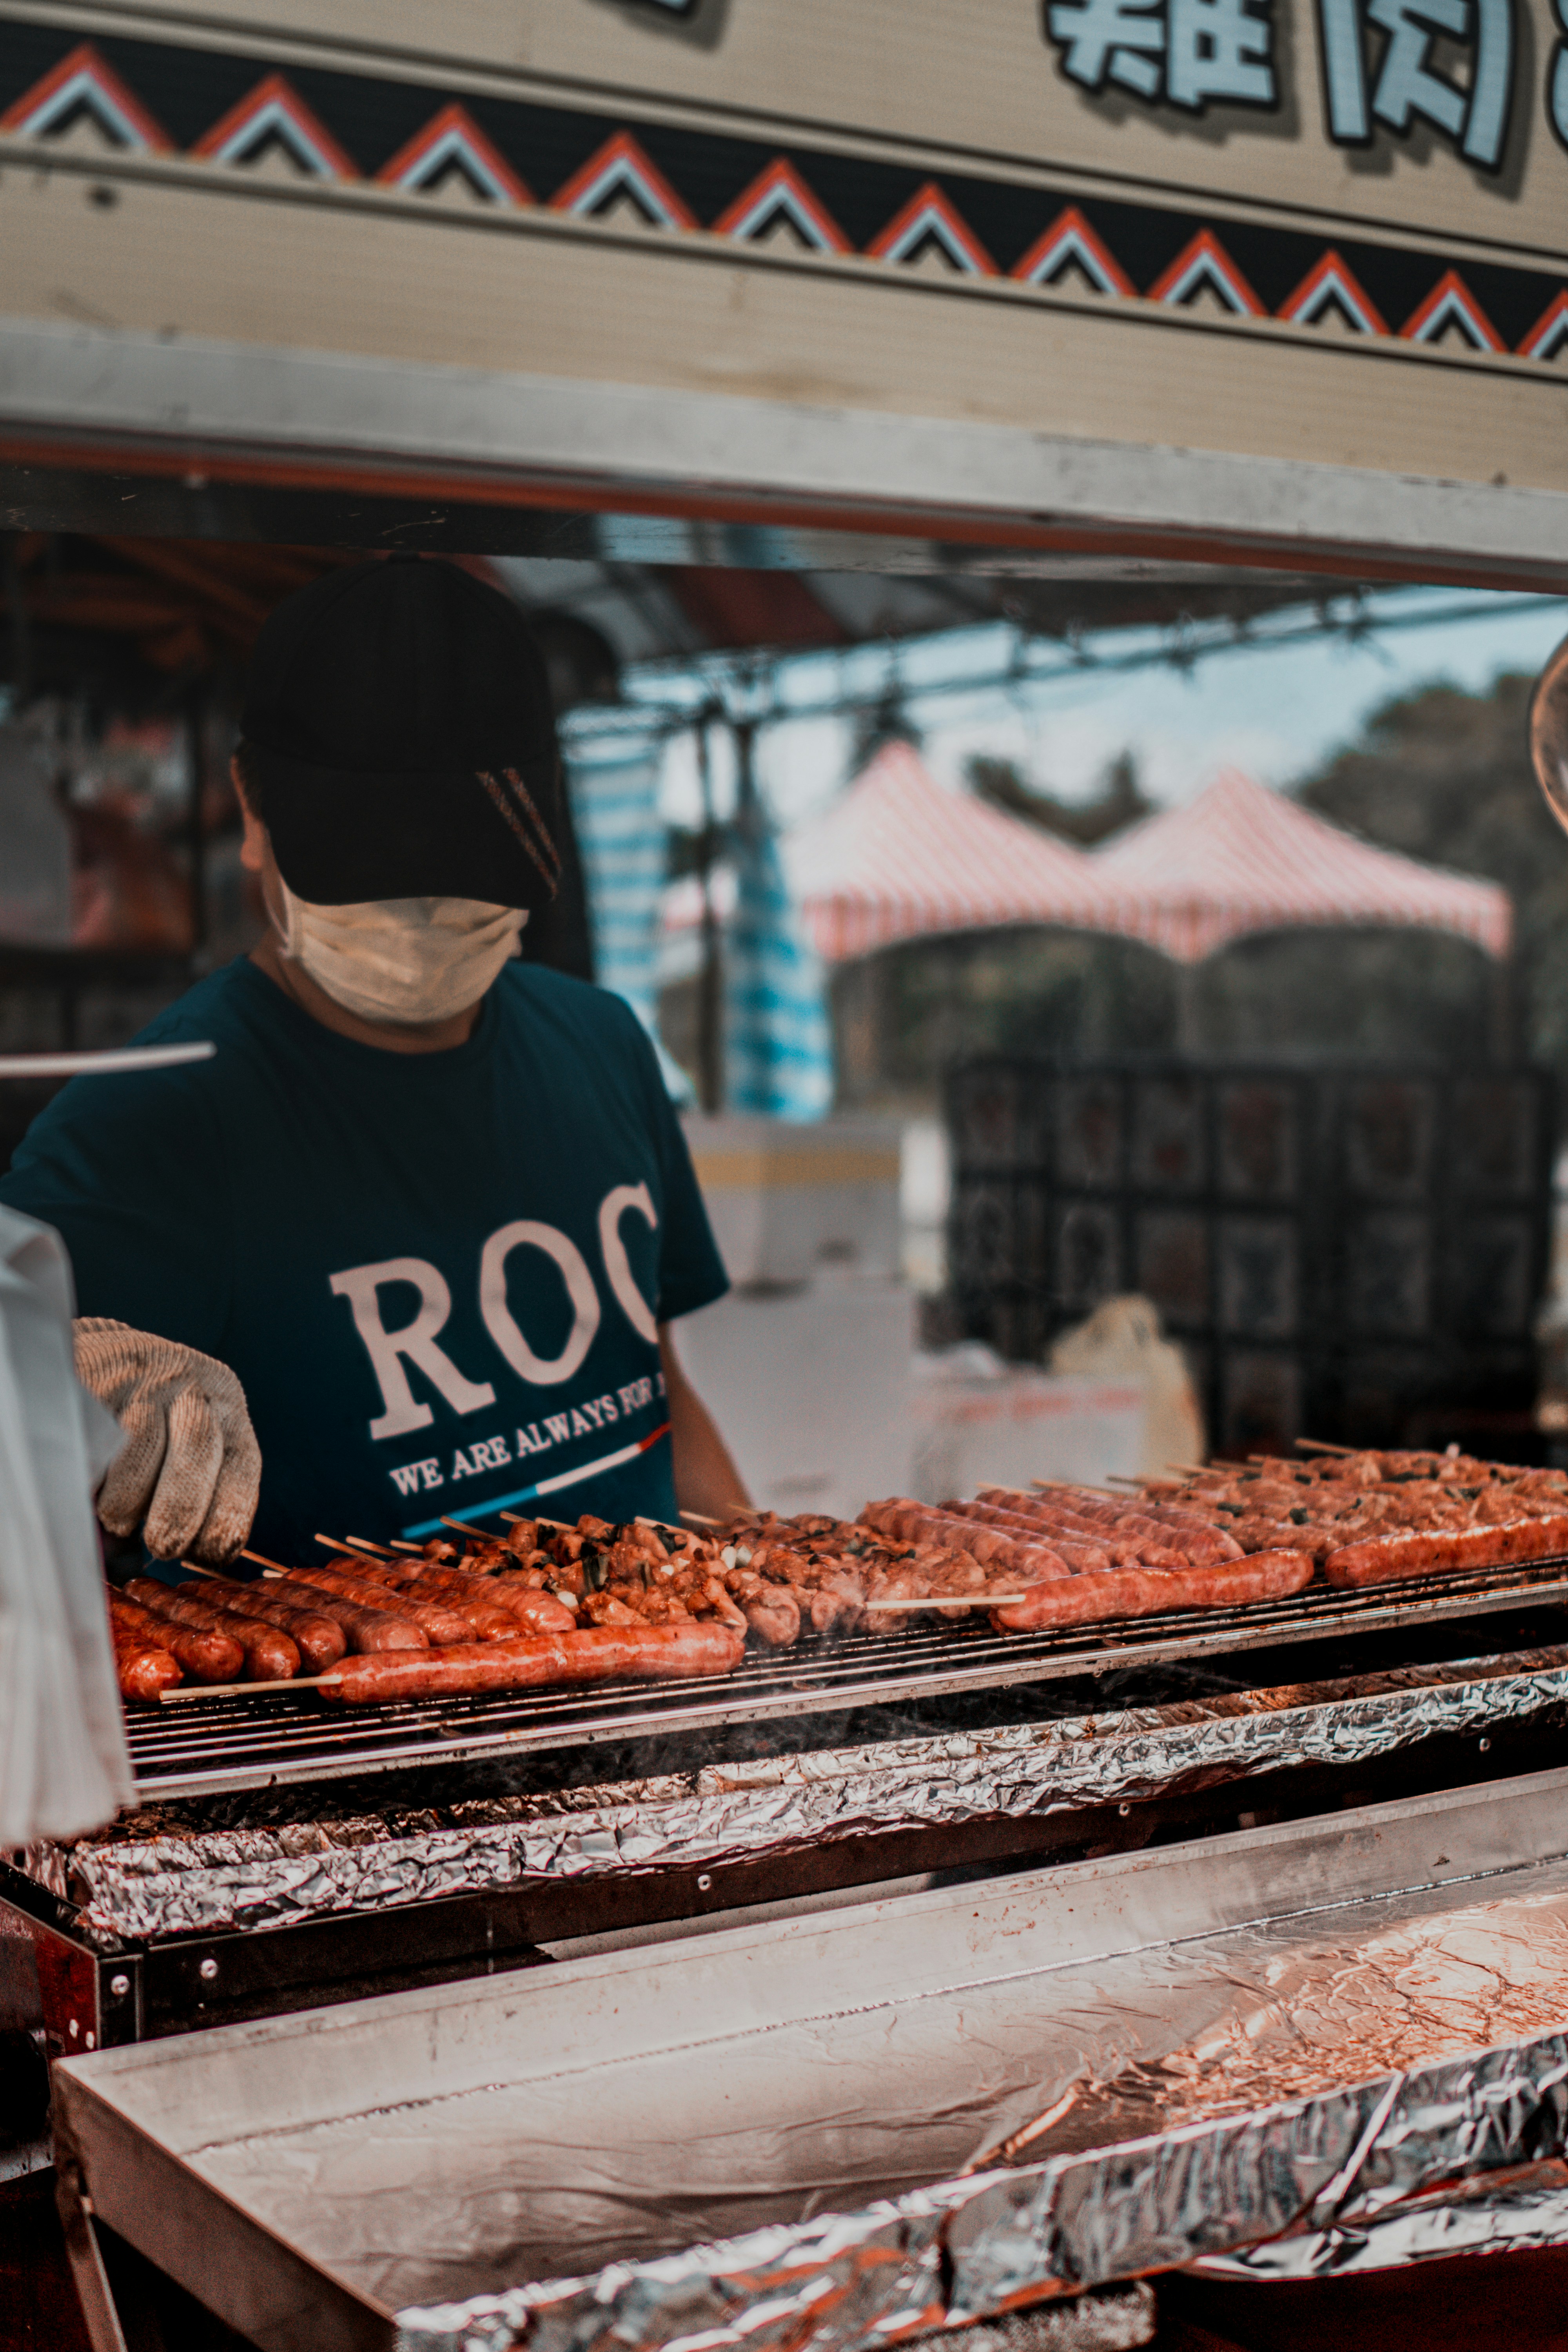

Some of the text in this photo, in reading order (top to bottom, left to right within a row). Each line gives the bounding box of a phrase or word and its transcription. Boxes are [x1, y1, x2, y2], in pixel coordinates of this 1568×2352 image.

[389, 1458, 443, 1495] WE
[452, 1436, 512, 1480] ARE
[516, 1395, 619, 1458] ALWAYS
[617, 1376, 653, 1415] FOR
